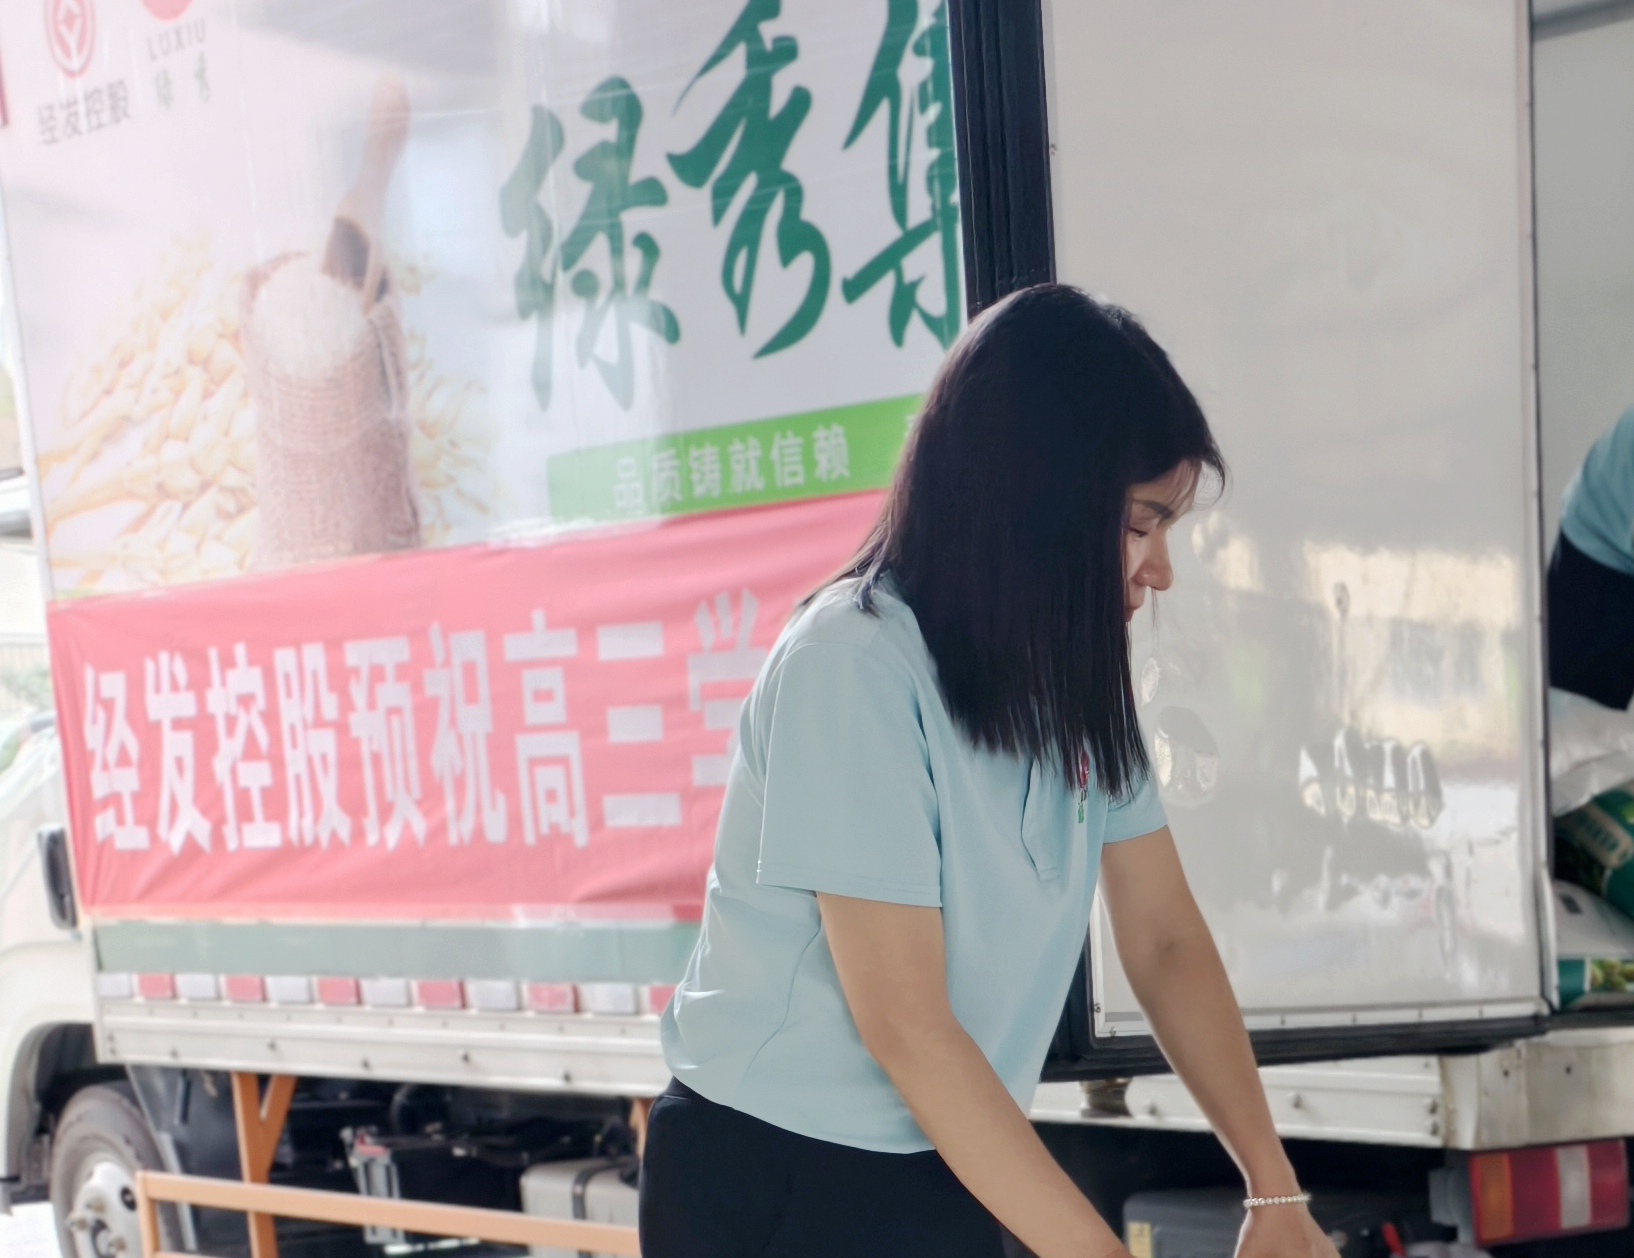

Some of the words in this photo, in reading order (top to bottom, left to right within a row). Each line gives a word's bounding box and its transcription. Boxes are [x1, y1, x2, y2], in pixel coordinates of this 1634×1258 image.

[614, 423, 850, 512] 品质铸就信赖
[83, 587, 768, 854] 经发控股预祝高三学
